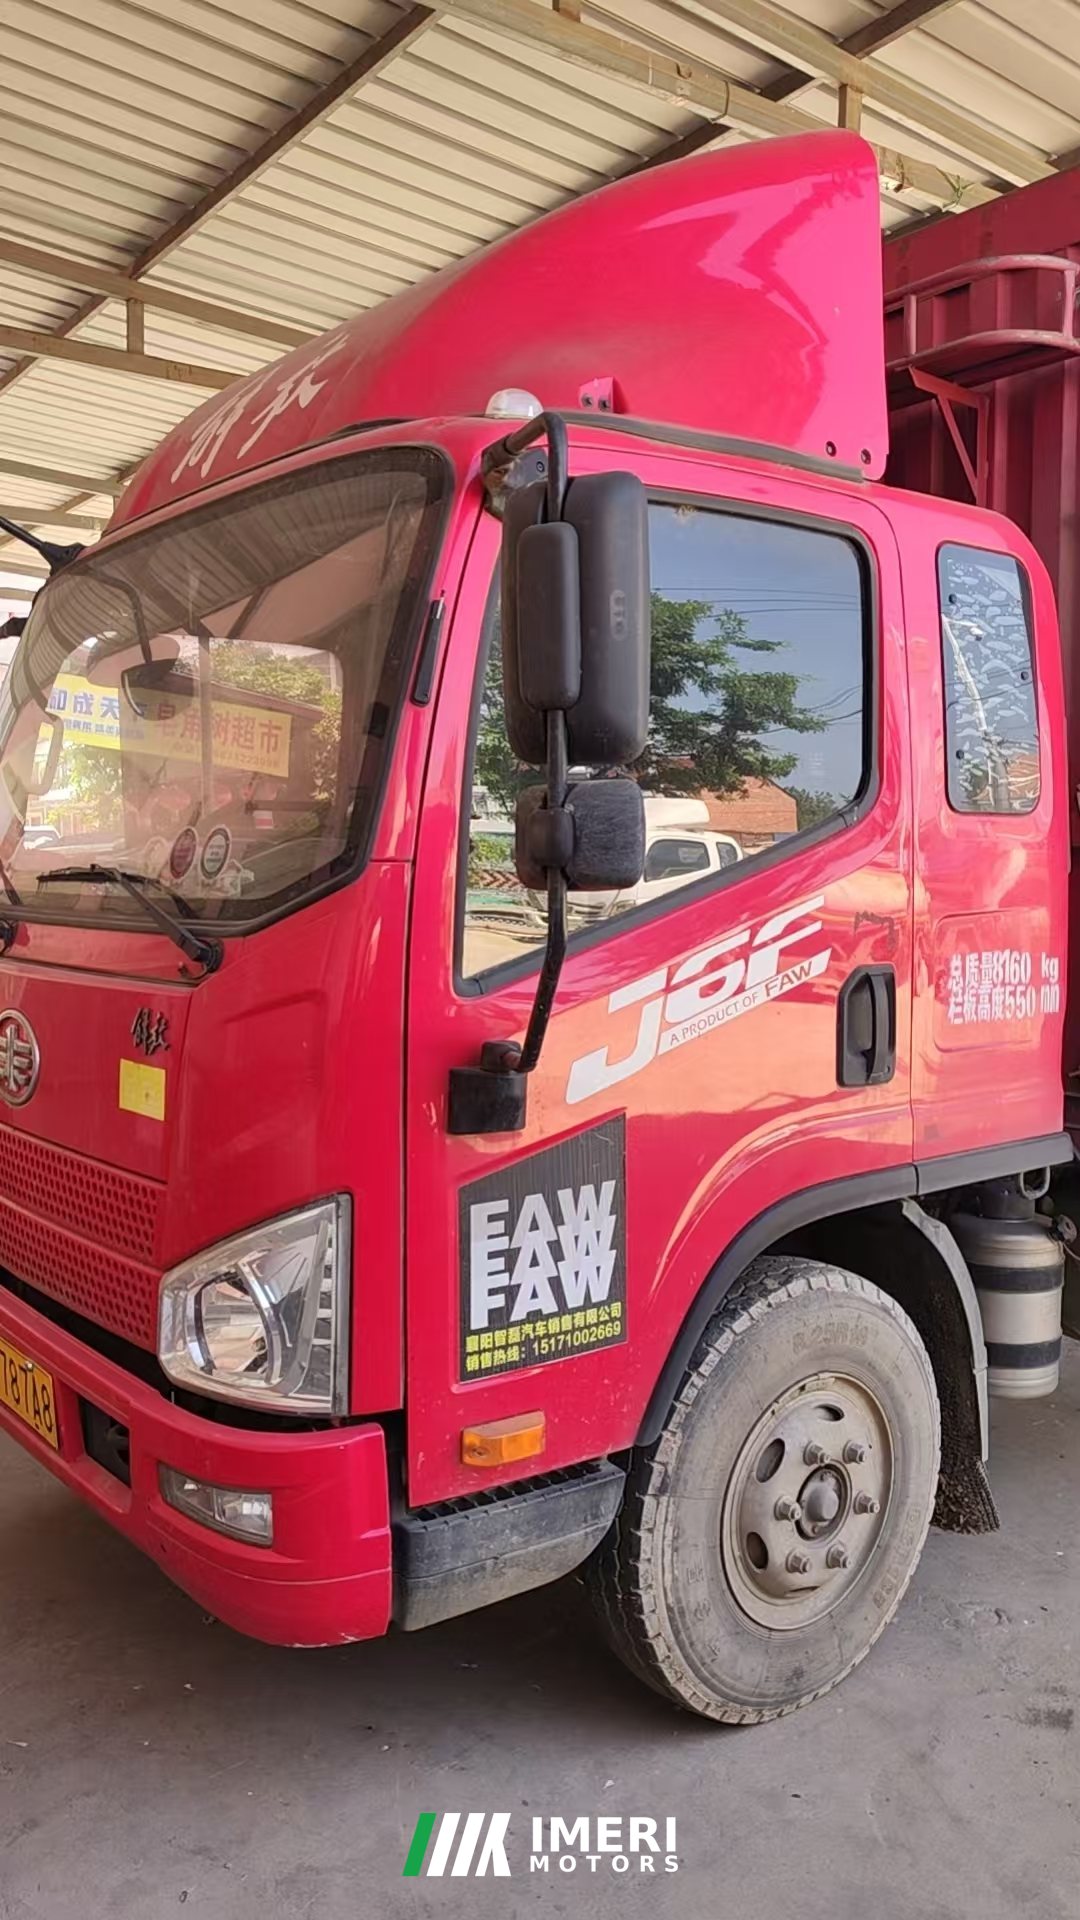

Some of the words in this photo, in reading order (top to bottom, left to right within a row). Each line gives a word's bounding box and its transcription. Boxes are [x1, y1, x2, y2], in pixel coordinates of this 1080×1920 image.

[1040, 951, 1060, 984] kg
[669, 1032, 680, 1046] A
[681, 1003, 740, 1038] PRODUCT
[741, 991, 760, 1008] OF
[764, 961, 813, 998] FAW
